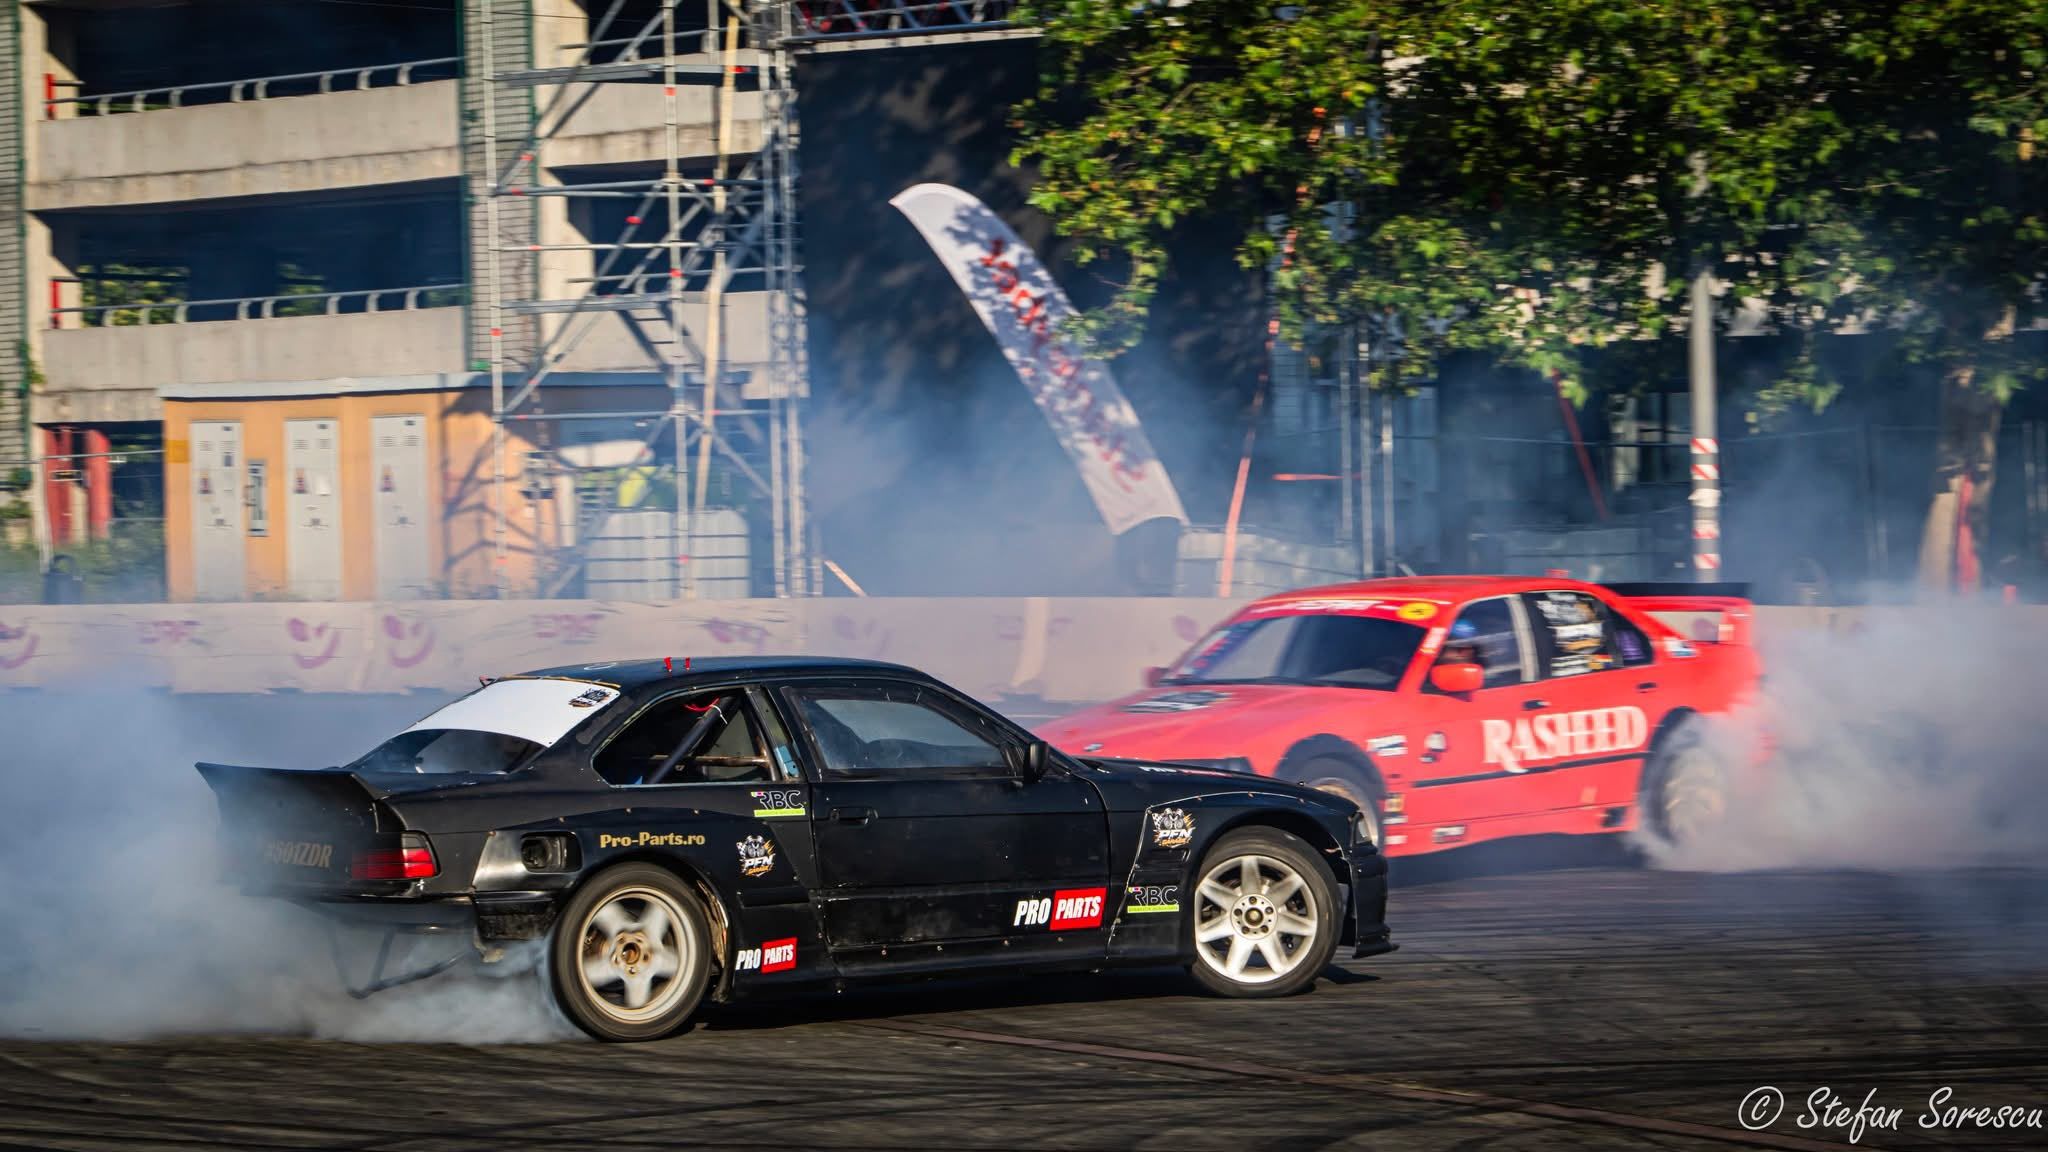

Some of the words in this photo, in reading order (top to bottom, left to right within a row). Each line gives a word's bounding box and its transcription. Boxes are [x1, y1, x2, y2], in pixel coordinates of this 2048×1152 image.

[1480, 706, 1648, 773] RASHEED
[751, 790, 804, 810] RBC
[600, 831, 706, 848] Pro-Parts.ro
[1128, 885, 1179, 906] RBC
[1013, 897, 1052, 926] PRO
[1055, 896, 1102, 920] PARTS
[735, 948, 762, 971] PRO
[763, 944, 794, 966] PARTS
